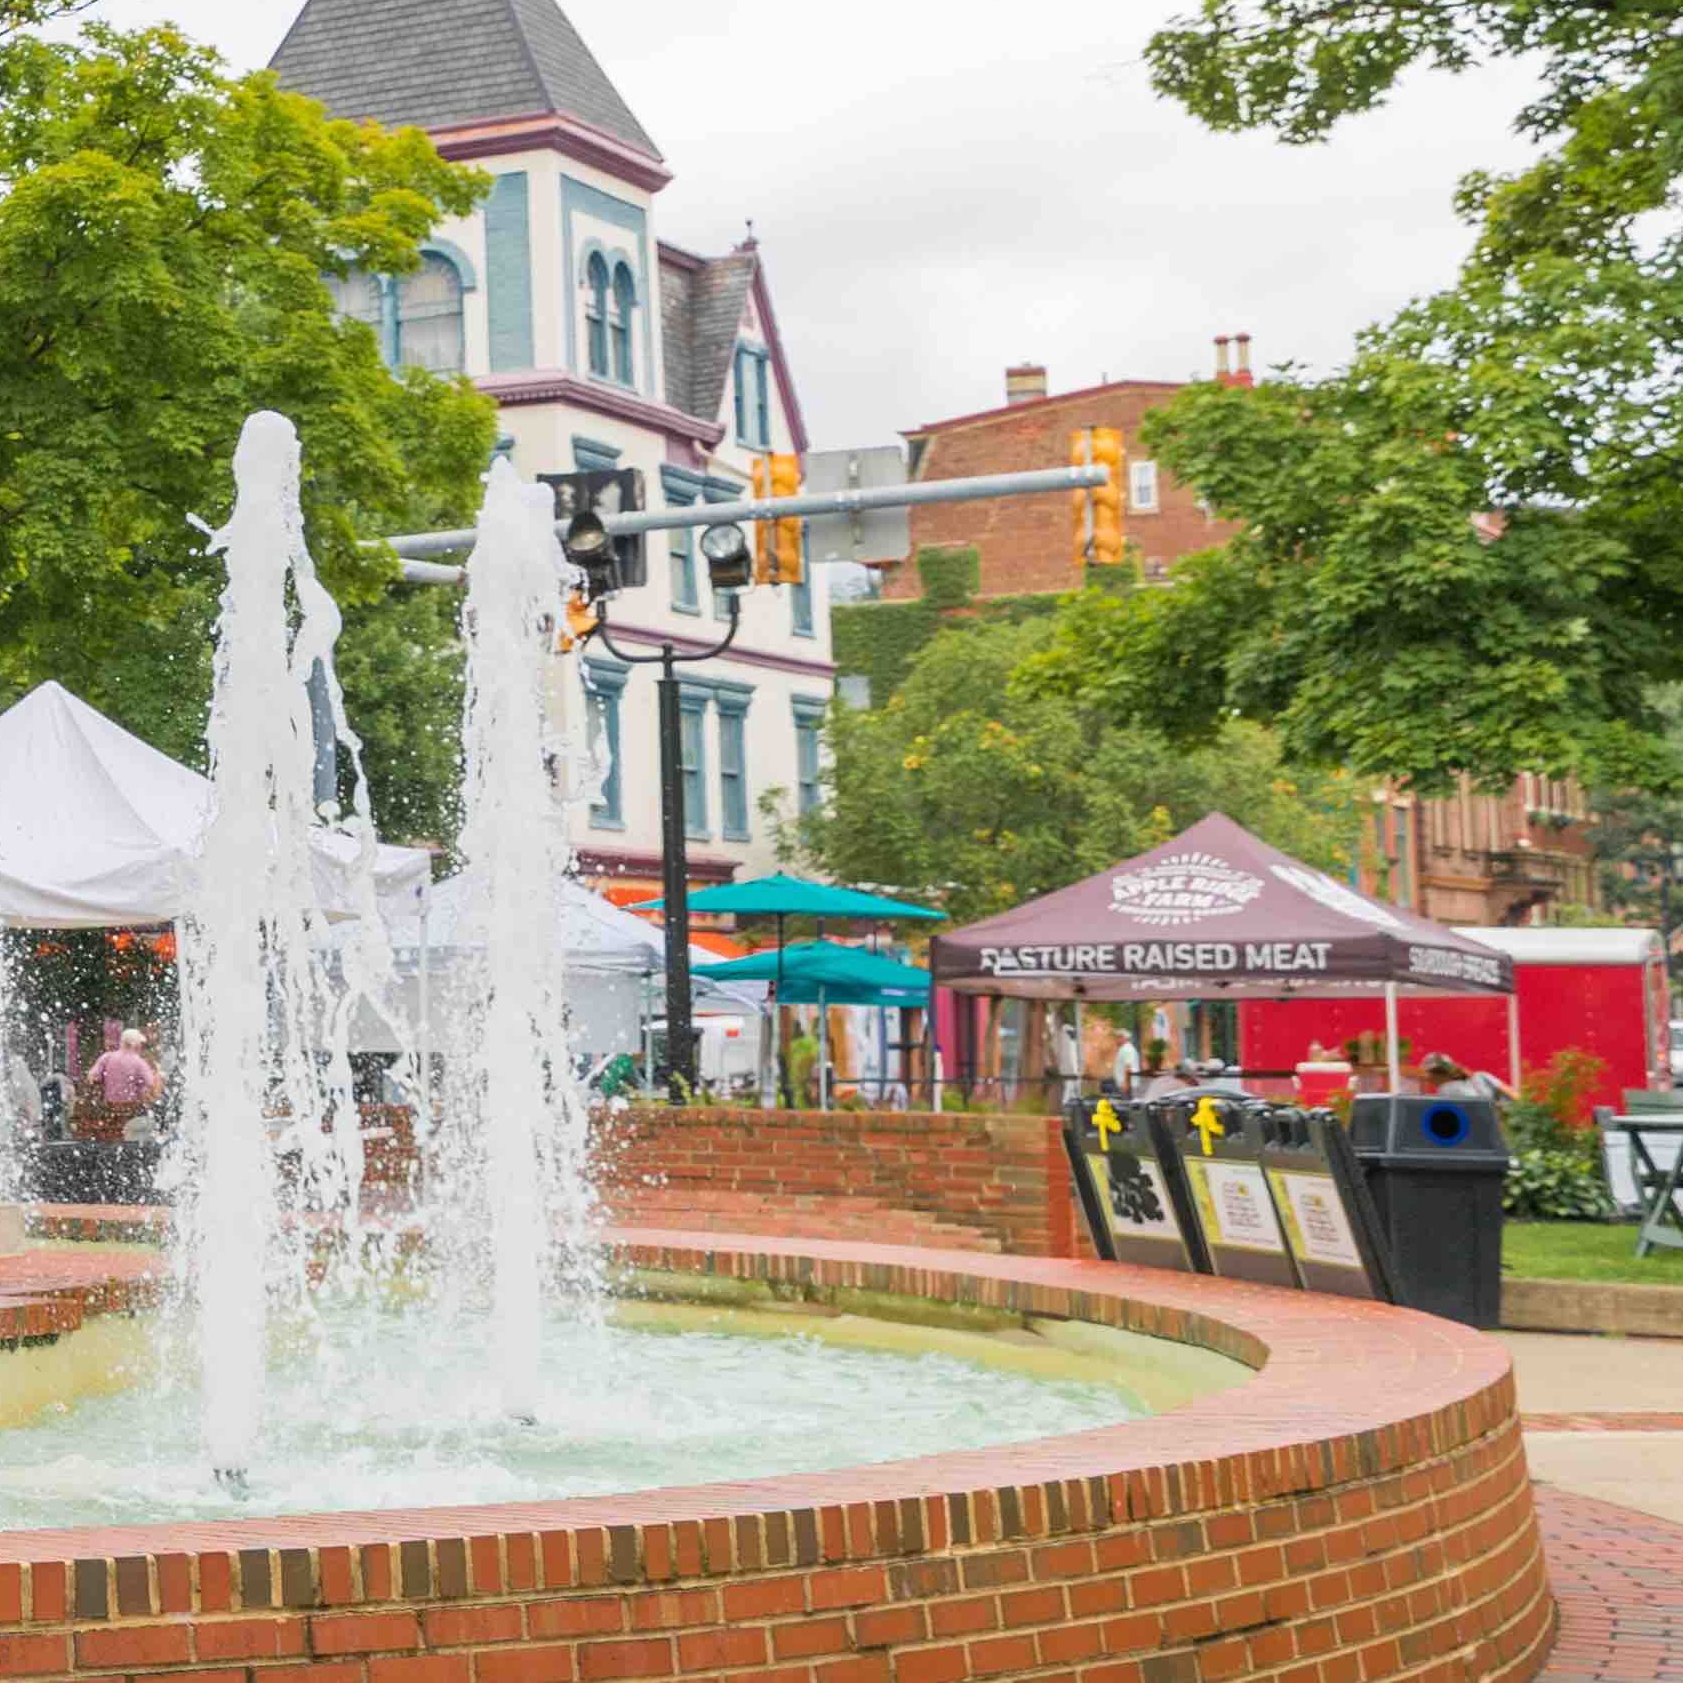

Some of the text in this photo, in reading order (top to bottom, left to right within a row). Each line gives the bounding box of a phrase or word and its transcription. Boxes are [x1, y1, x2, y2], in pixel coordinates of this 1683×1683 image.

[980, 942, 1331, 972] PASTURE RAISED MEAT
